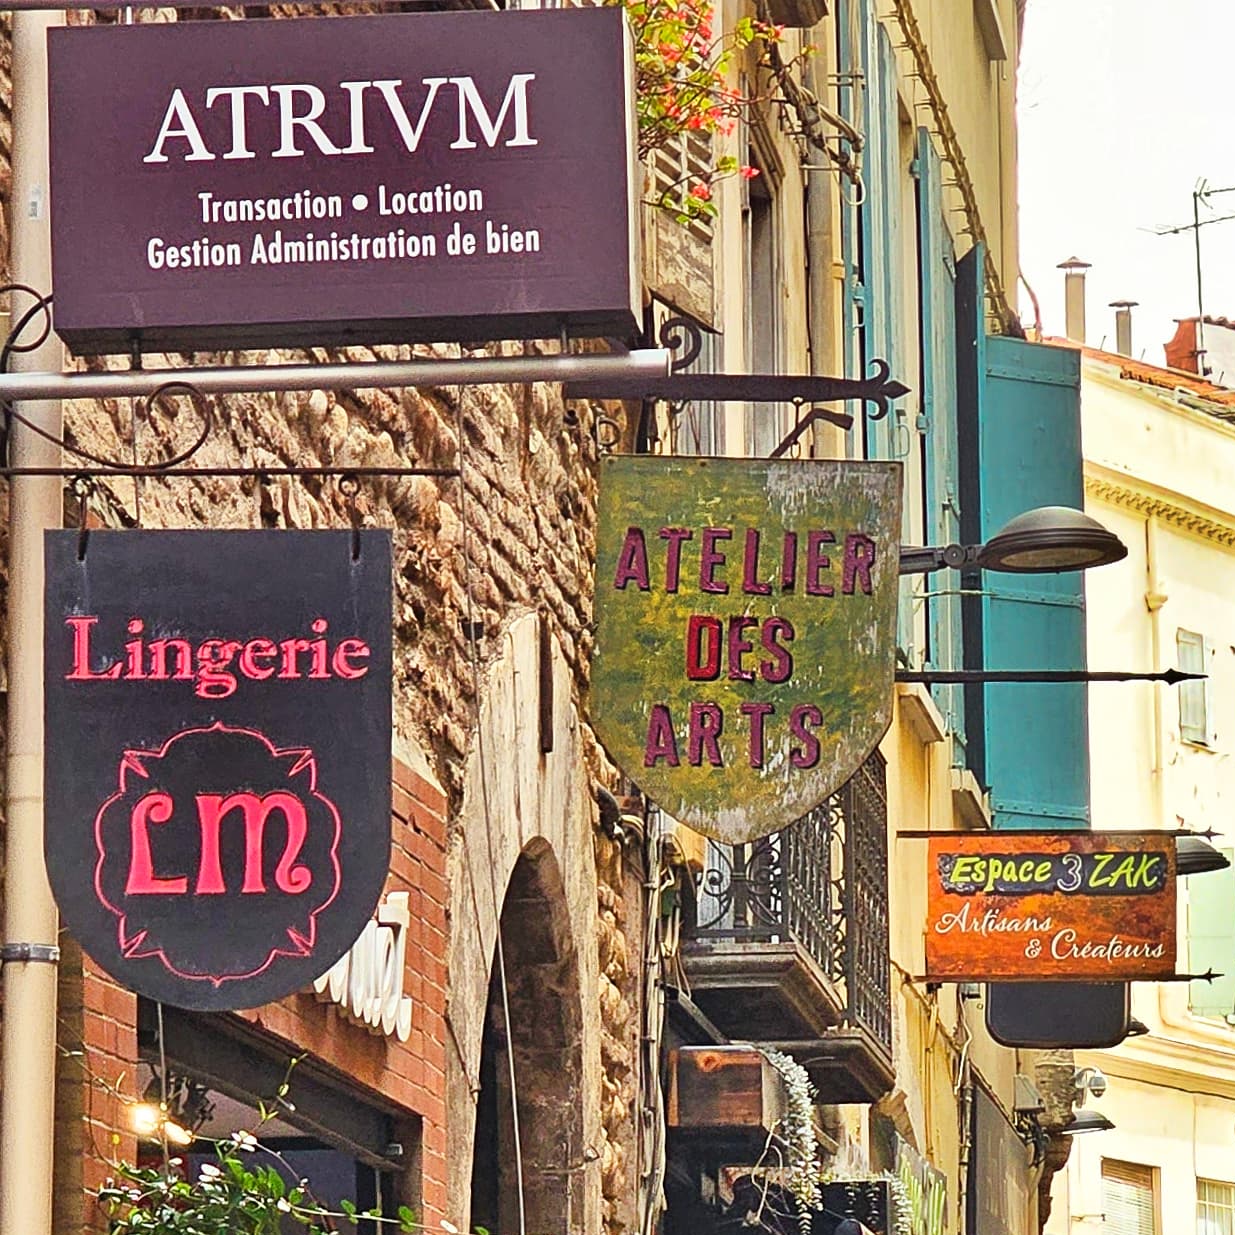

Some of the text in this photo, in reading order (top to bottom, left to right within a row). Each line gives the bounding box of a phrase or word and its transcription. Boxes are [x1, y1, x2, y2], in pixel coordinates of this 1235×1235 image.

[143, 74, 538, 163] ATRIVM
[198, 184, 483, 223] Transaction Location
[147, 220, 540, 269] Gestion Administration de bien
[614, 526, 877, 597] ATELIER
[65, 615, 371, 698] Lingerie
[686, 615, 796, 683] DES
[644, 701, 824, 769] ARTS
[125, 790, 312, 895] LM
[950, 854, 1161, 892] Espace 3 ZAK
[935, 903, 1053, 937] Artisans
[1025, 938, 1042, 959] &
